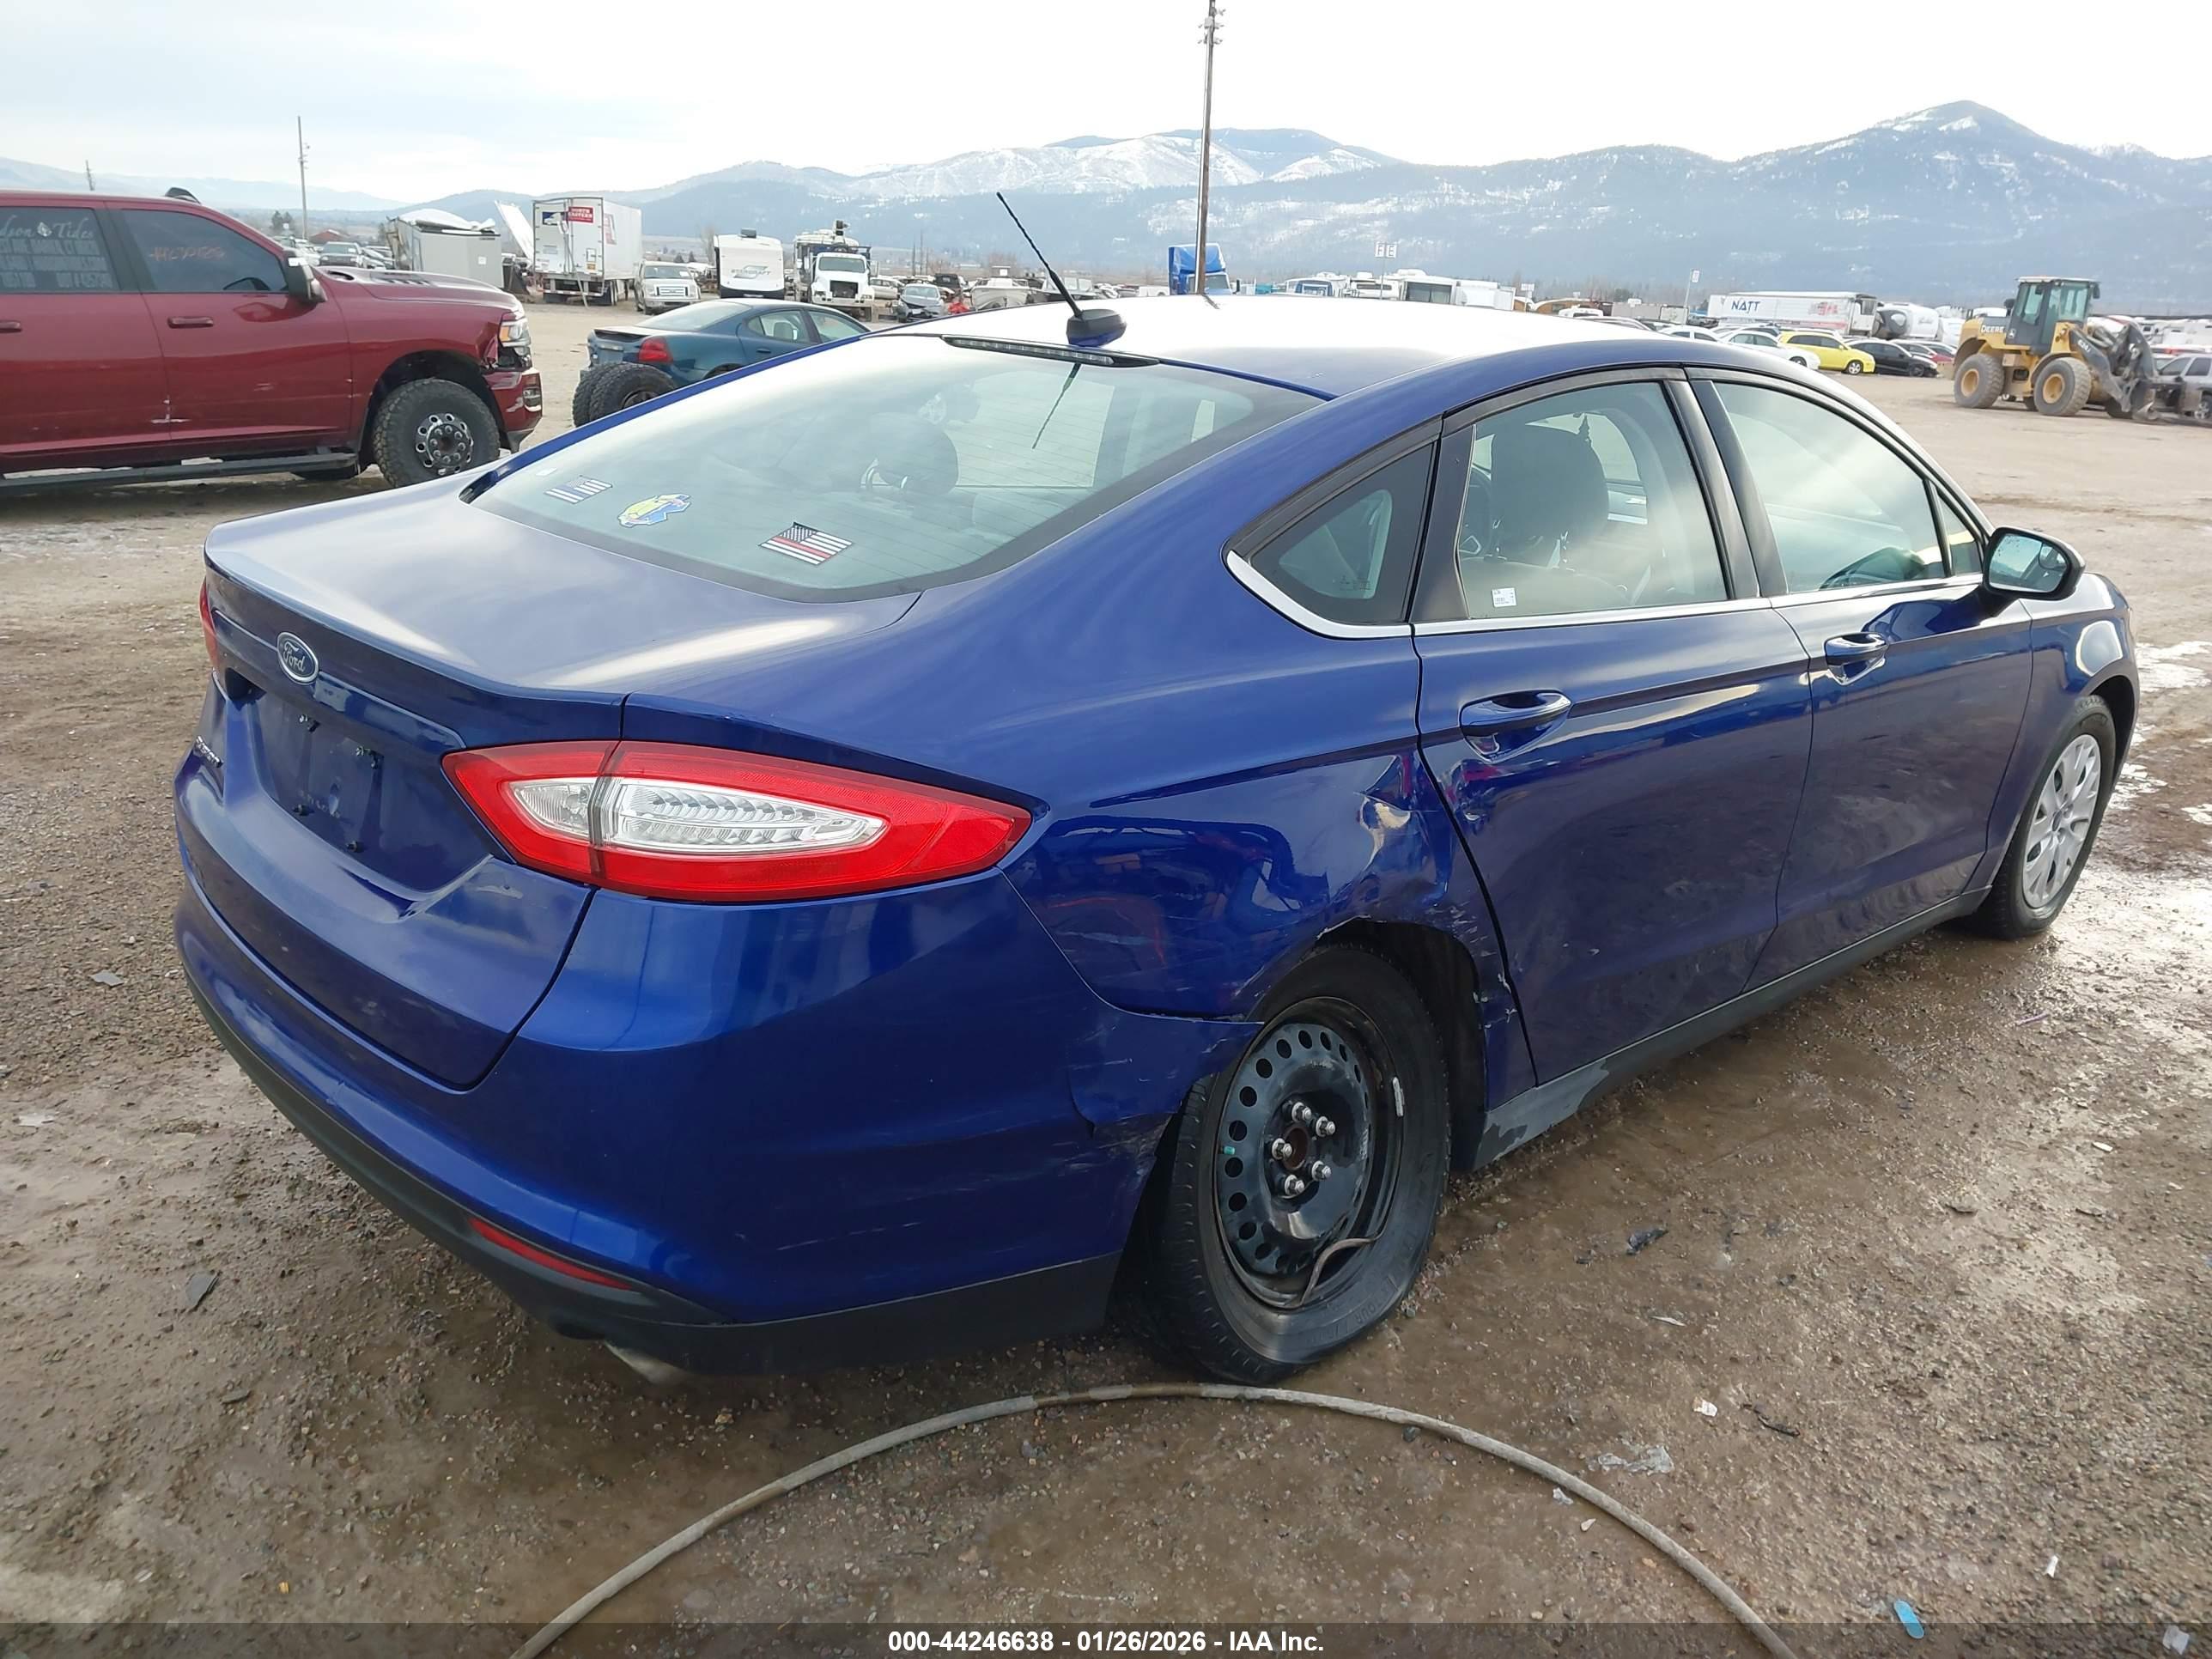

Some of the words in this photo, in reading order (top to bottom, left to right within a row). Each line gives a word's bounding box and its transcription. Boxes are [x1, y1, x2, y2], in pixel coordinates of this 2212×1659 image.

[1731, 300, 1760, 313] NATT
[1980, 325, 2005, 334] DEERE
[283, 641, 306, 673] Ford
